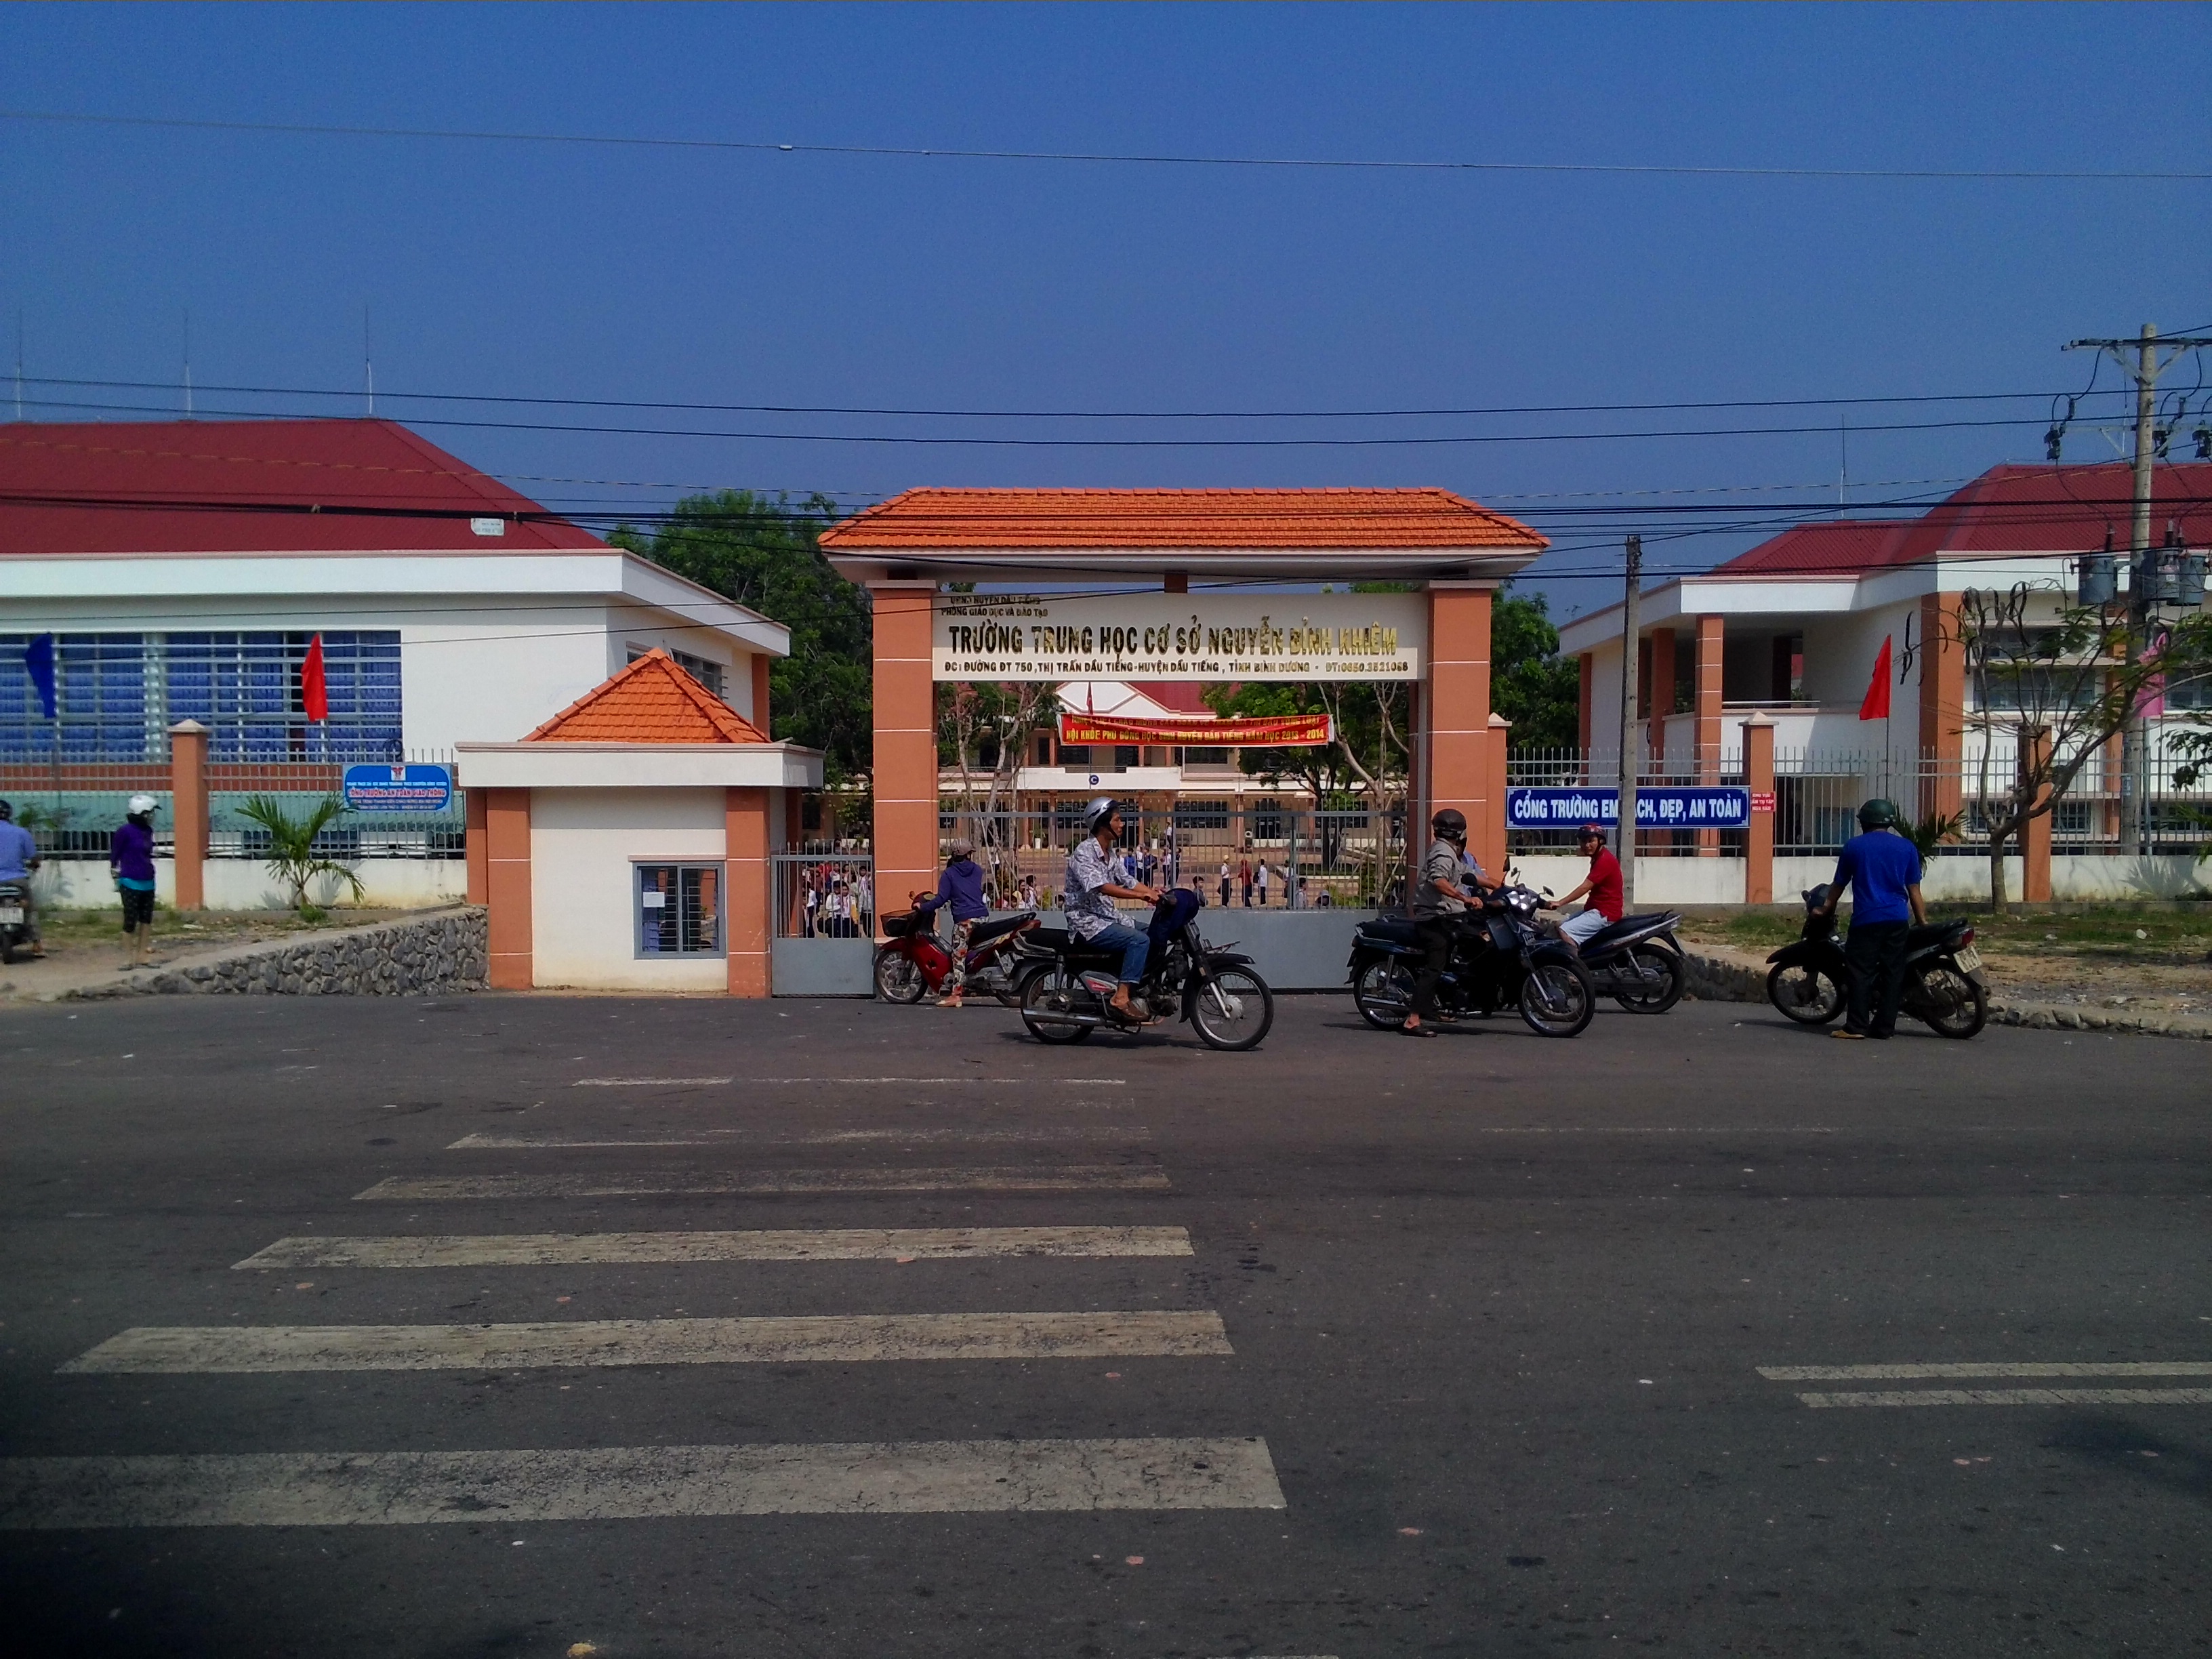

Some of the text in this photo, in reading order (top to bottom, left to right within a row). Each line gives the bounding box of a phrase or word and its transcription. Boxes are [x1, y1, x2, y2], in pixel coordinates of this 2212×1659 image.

[969, 605, 987, 616] GIÁO
[1033, 608, 1048, 618] TẠO
[949, 618, 1023, 655] TRƯỜNG
[1031, 626, 1092, 655] TRUNG
[1099, 626, 1138, 662] HỌC
[1144, 622, 1170, 655] CƠ
[1176, 614, 1202, 655] SỞ
[1208, 615, 1284, 656] NGUYỄN
[1338, 621, 1397, 656] KHIÊM
[964, 659, 997, 672] ĐƯỜNG
[1000, 661, 1012, 672] ĐT
[1015, 661, 1033, 672] 750
[1057, 659, 1082, 672] TRẤN
[1228, 658, 1251, 672] TỈNH
[1254, 659, 1276, 672] BÌNH
[1278, 659, 1310, 672] DƯƠNG
[1306, 729, 1324, 739] 2014
[1515, 790, 1742, 823] CỔNG TRƯỜNG EM CH, ĐẸP, AN TOÀN
